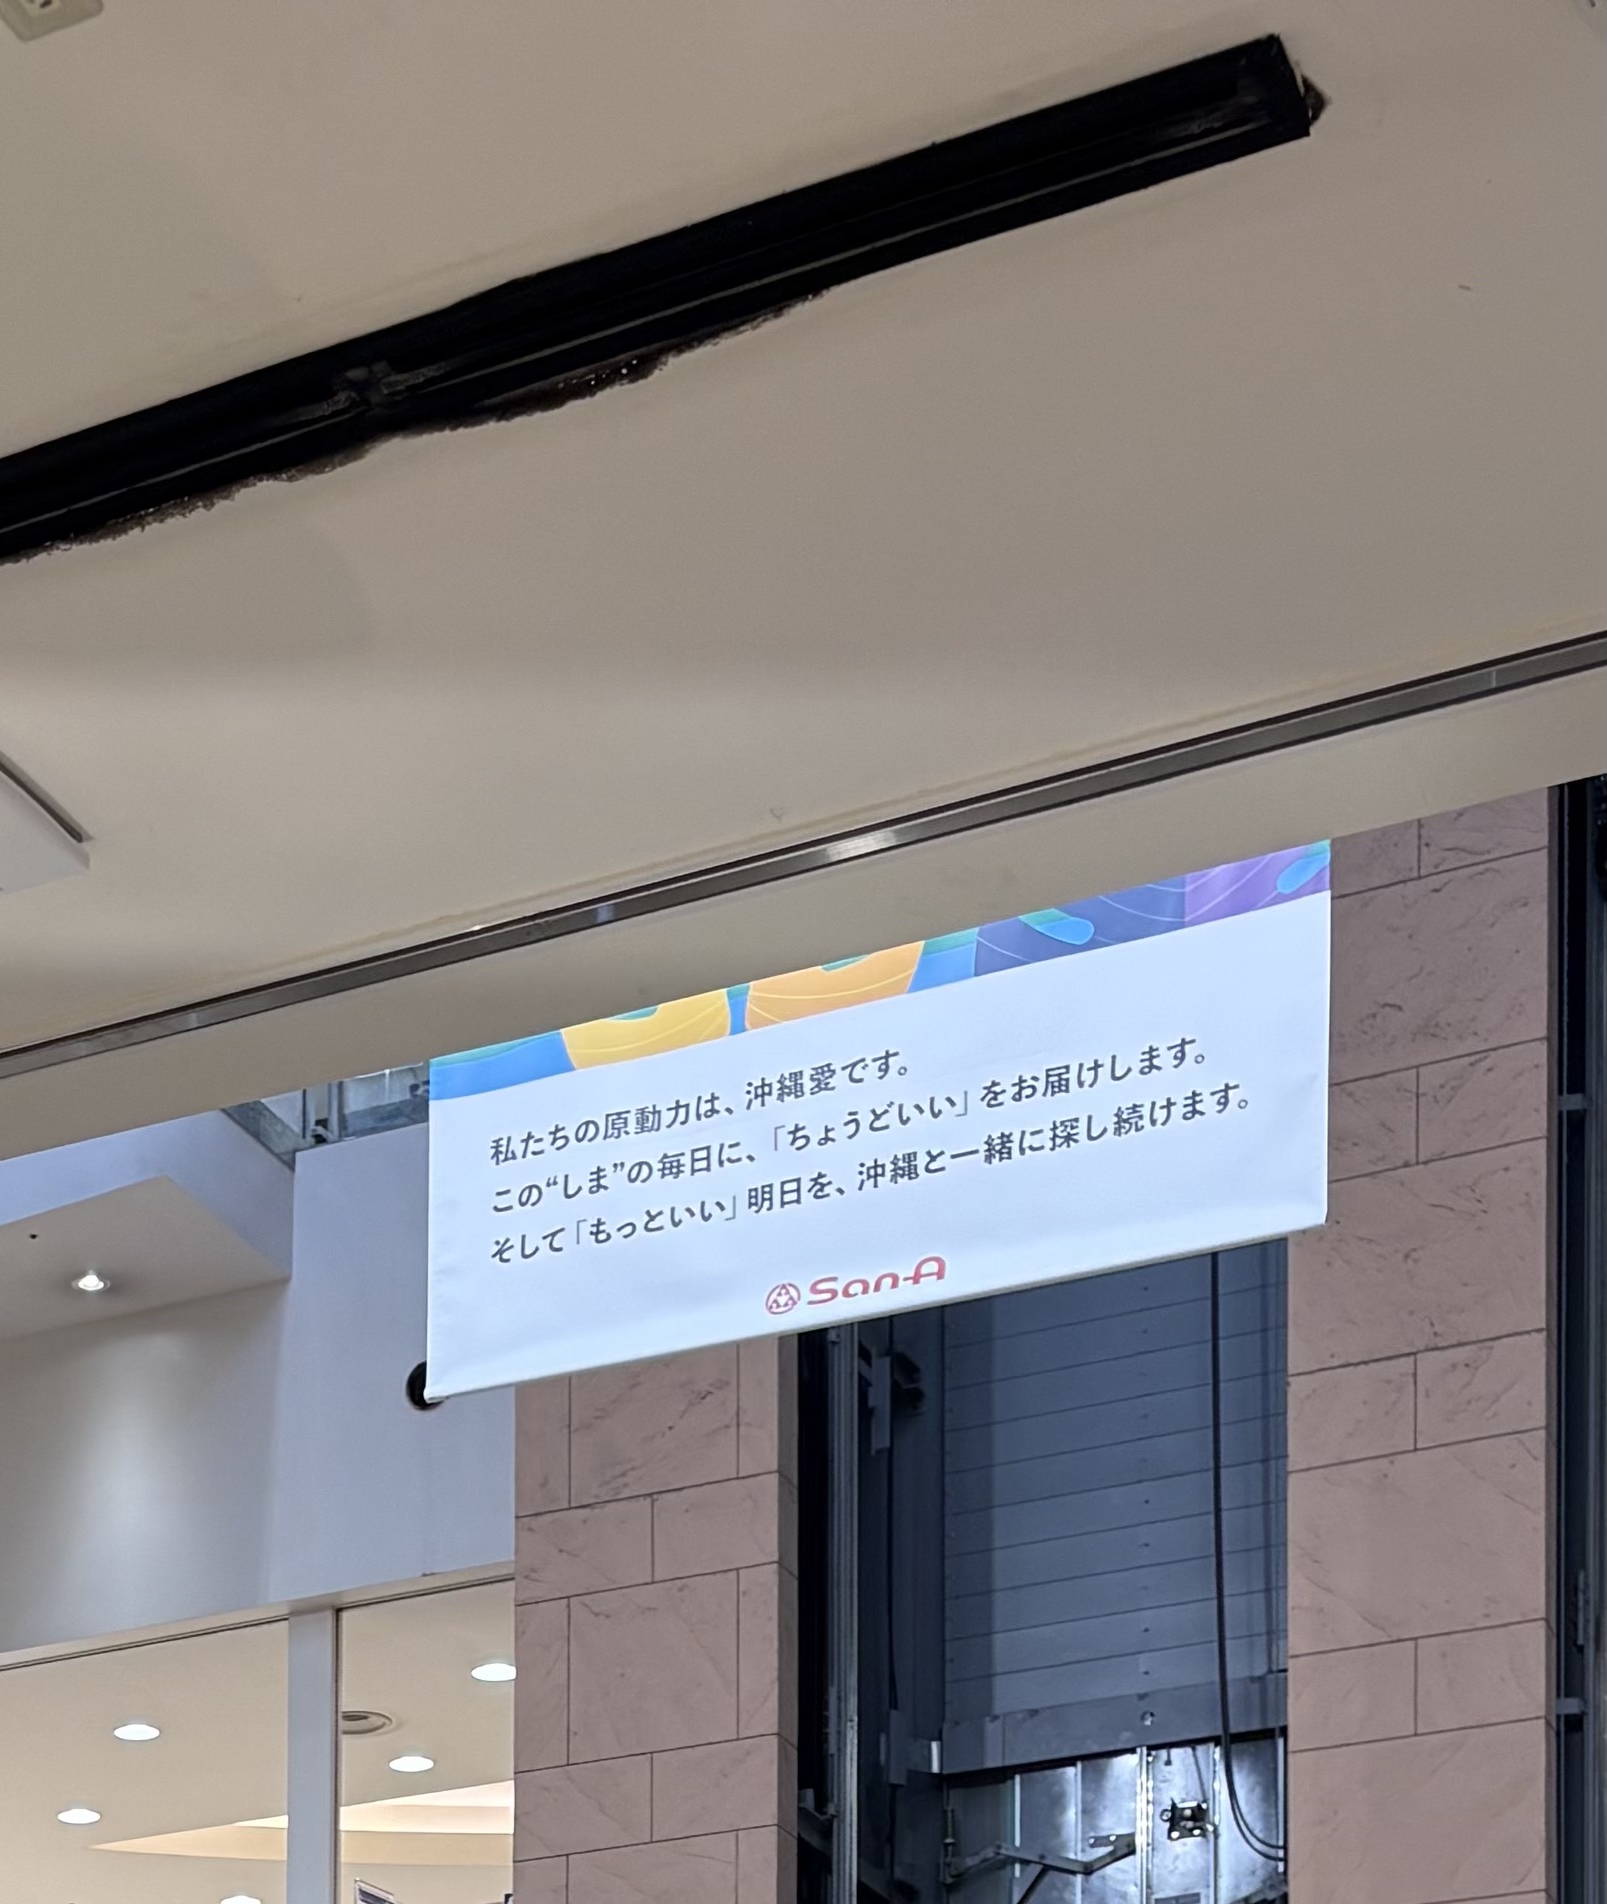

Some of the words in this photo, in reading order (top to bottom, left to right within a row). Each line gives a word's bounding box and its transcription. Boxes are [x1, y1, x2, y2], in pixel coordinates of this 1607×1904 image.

[489, 1048, 910, 1167] 私たちの原動力は、沖縄愛です。
[490, 1083, 1250, 1264] そして「もっといい」明日を、沖縄と一緒に探し続けます。
